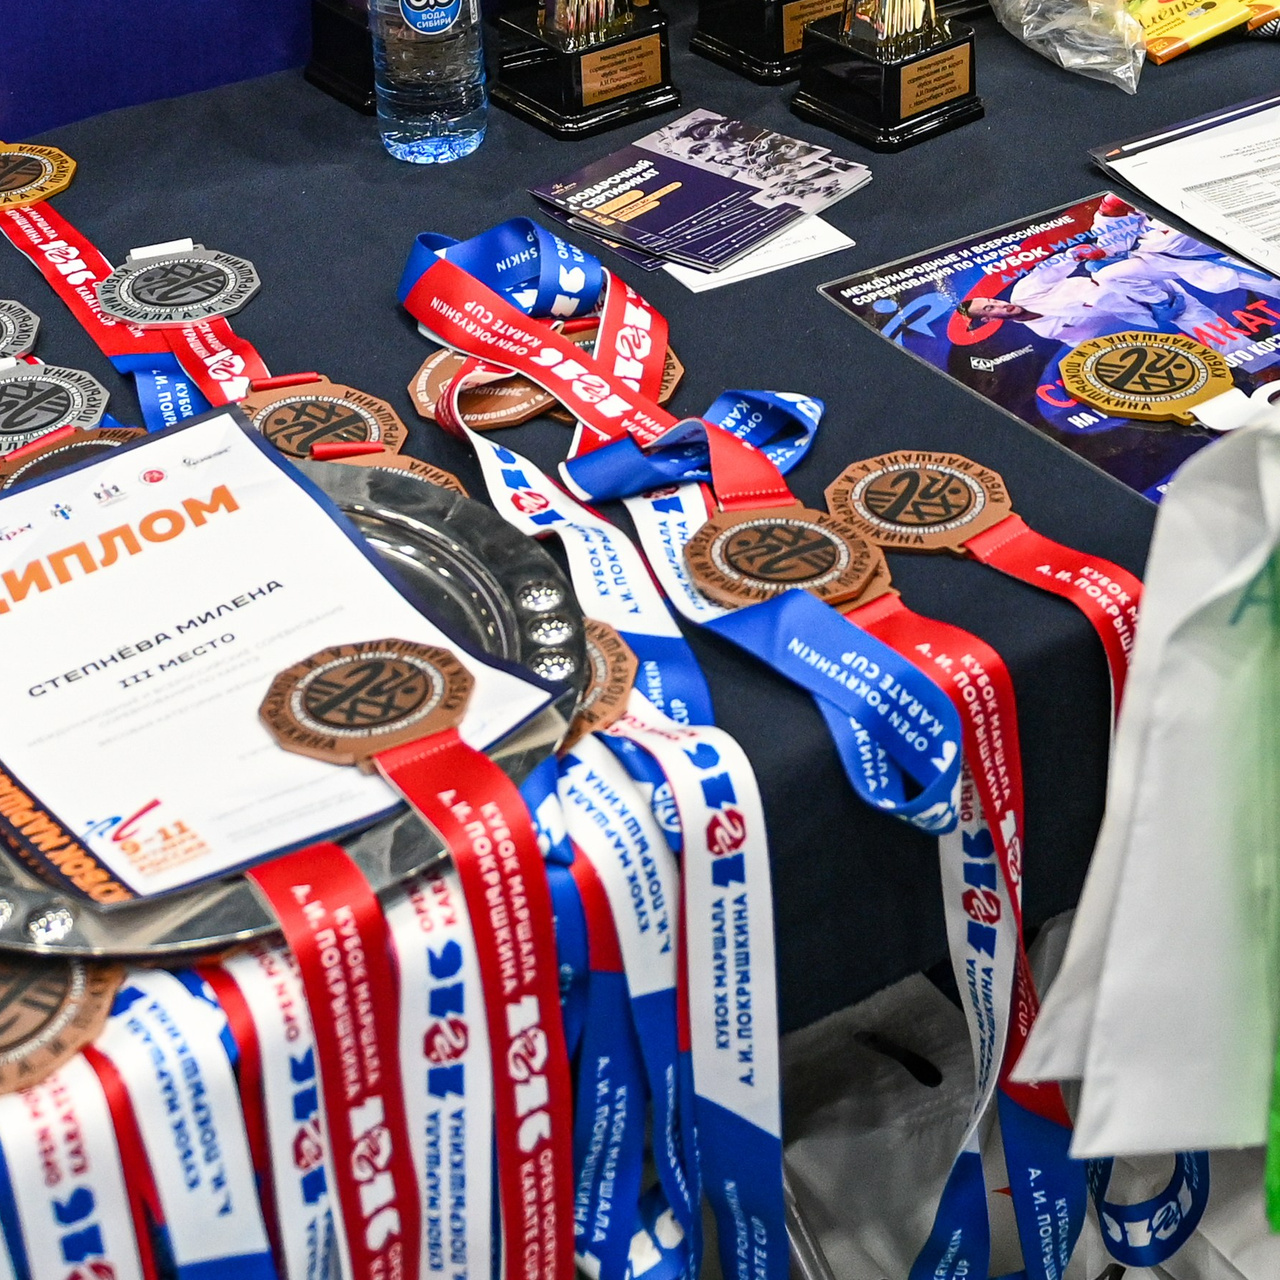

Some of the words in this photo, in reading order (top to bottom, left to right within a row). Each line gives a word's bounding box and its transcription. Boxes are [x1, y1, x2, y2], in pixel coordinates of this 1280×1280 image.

[417, 17, 451, 28] СИБИРИ
[422, 11, 446, 20] ВОДА
[18, 145, 69, 189] ПОКРЫШКИНА
[566, 160, 654, 204] ПОДАРОЧНЫЙ
[582, 168, 660, 208] СЕРТИФИКАТ
[841, 252, 963, 299] МЕЖДУНАРОДНЫЕ
[962, 248, 973, 257] И
[972, 214, 1075, 255] ВСЕРОССИЙСКИЕ
[982, 246, 1051, 275] КУБОК
[1049, 213, 1143, 252] МАРШАЛА
[107, 295, 174, 321] МАРШАЛА
[213, 253, 255, 307] ПОКРЫШКИНА
[851, 266, 956, 306] СОРЕВНОВАНИЯ
[954, 258, 973, 272] ПО
[972, 243, 1021, 264] КАРАТЭ
[430, 296, 506, 348] POKRYSHKIN
[464, 300, 494, 322] CUP
[490, 313, 541, 348] KARATE
[502, 336, 528, 356] OPEN
[1103, 332, 1197, 349] МАРШАЛА
[1196, 347, 1227, 379] КУБОК
[42, 366, 102, 423] ПОКРЫШКИНА
[174, 383, 194, 416] КУБОК
[1066, 362, 1152, 411] ПОКРЫШКИНА
[873, 452, 975, 470] МАРШАЛА
[587, 547, 610, 596] КУБОК
[1079, 565, 1133, 611] КУБОК
[27, 630, 173, 699] СТЕПНЁВА
[174, 578, 285, 635] МИЛЕНА
[156, 632, 237, 673] МЕСТО
[788, 637, 890, 715] POKRYSHKIN
[840, 651, 880, 679] CUP
[879, 673, 944, 738] KARATE
[960, 653, 998, 712] КУБОК
[983, 711, 1012, 800] МАРШАЛА
[888, 711, 928, 752] OPEN
[952, 675, 1004, 814] ПОКРЫШКИНА
[479, 801, 521, 875] КУБОК
[566, 785, 632, 869] МАРШАЛА
[586, 770, 667, 911] ПОКРЫШКИНА
[466, 820, 520, 997] ПОКРЫШКИНА
[626, 867, 650, 935] КУБОК
[712, 897, 728, 996] МАРШАЛА
[733, 892, 754, 1040] ПОКРЫШКИНА
[716, 998, 729, 1050] КУБОК
[736, 1041, 754, 1064] И.
[739, 1065, 756, 1087] А.
